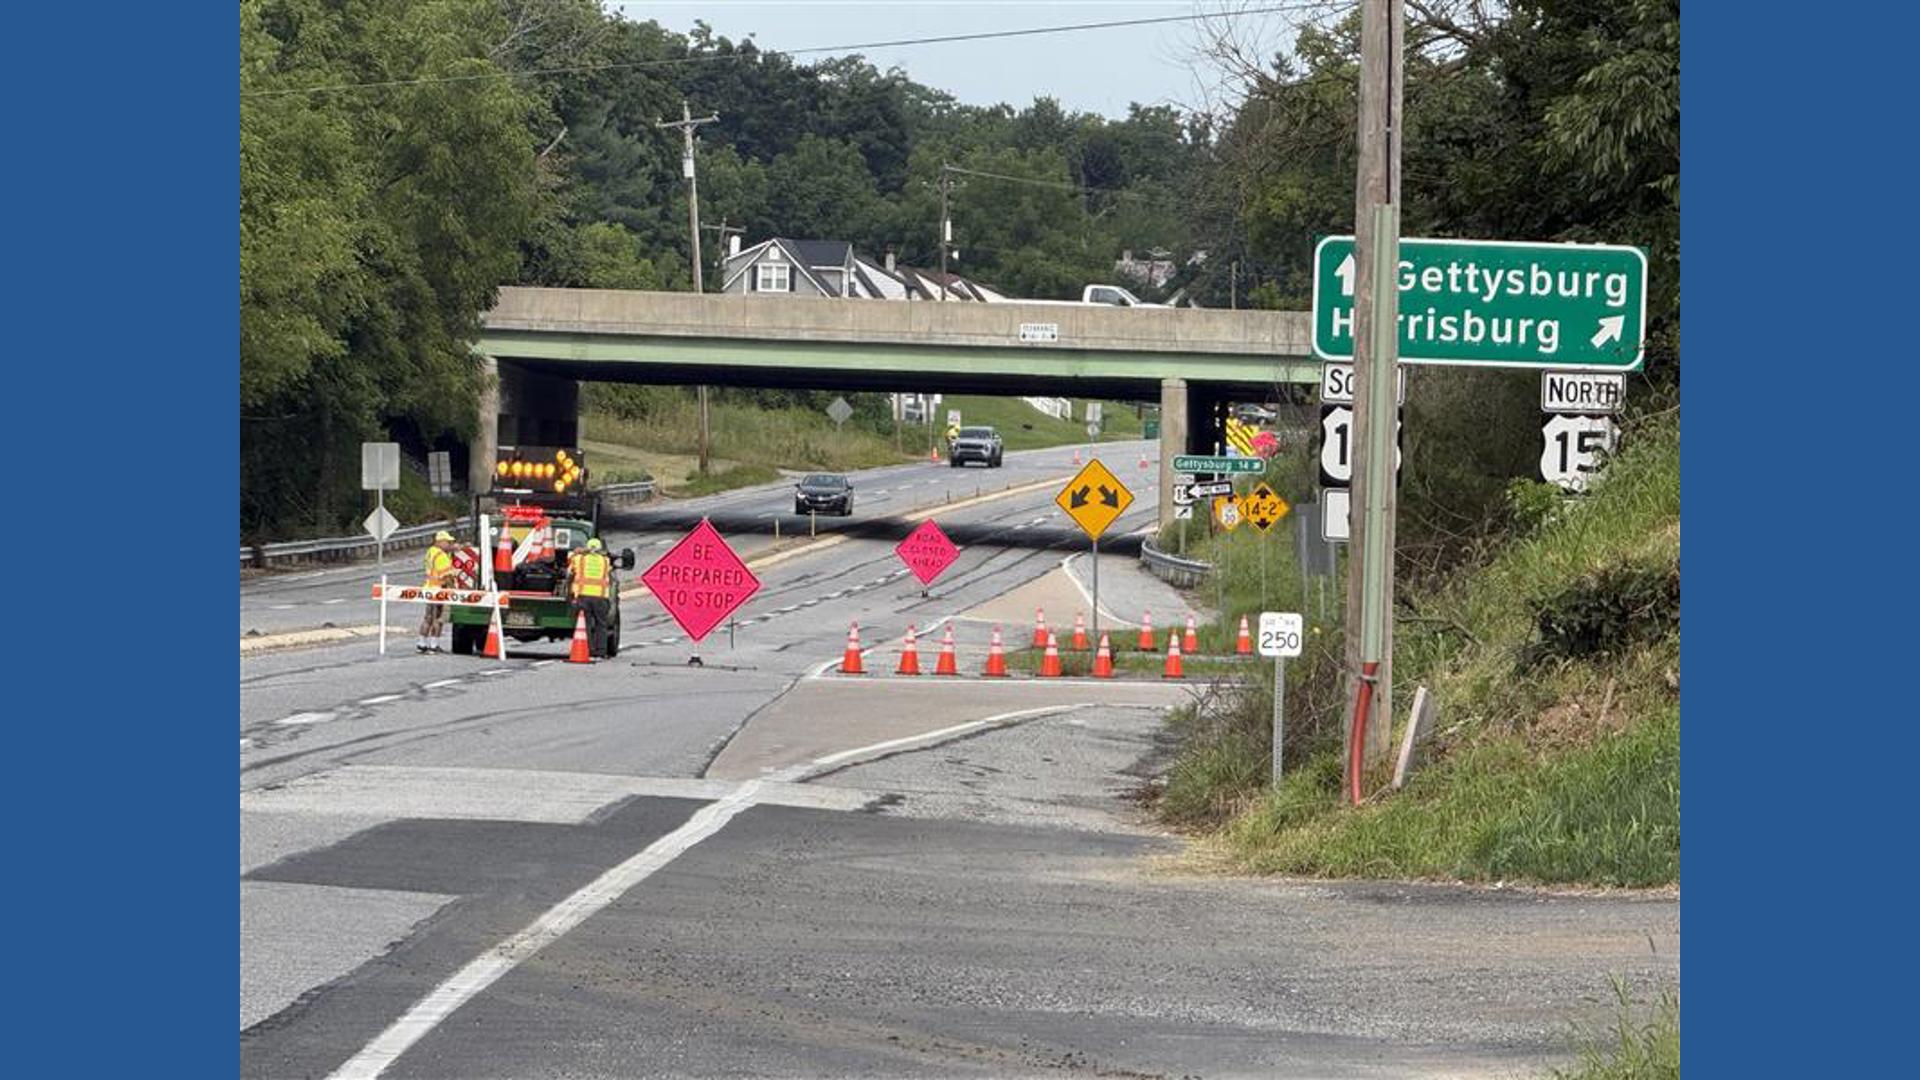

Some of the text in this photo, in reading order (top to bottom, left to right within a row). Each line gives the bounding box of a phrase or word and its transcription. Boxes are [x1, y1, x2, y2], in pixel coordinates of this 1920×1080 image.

[1398, 262, 1627, 306] Gettysburg
[1332, 308, 1559, 353] Hrisburg
[1549, 378, 1618, 404] NORTH
[1555, 431, 1609, 474] 15
[1175, 459, 1233, 472] Gettysburg
[693, 543, 714, 561] BE
[660, 565, 743, 586] PREPARED
[400, 589, 482, 603] ROAD CLOSED
[667, 590, 734, 609] TO STOP
[1261, 631, 1299, 649] 250
